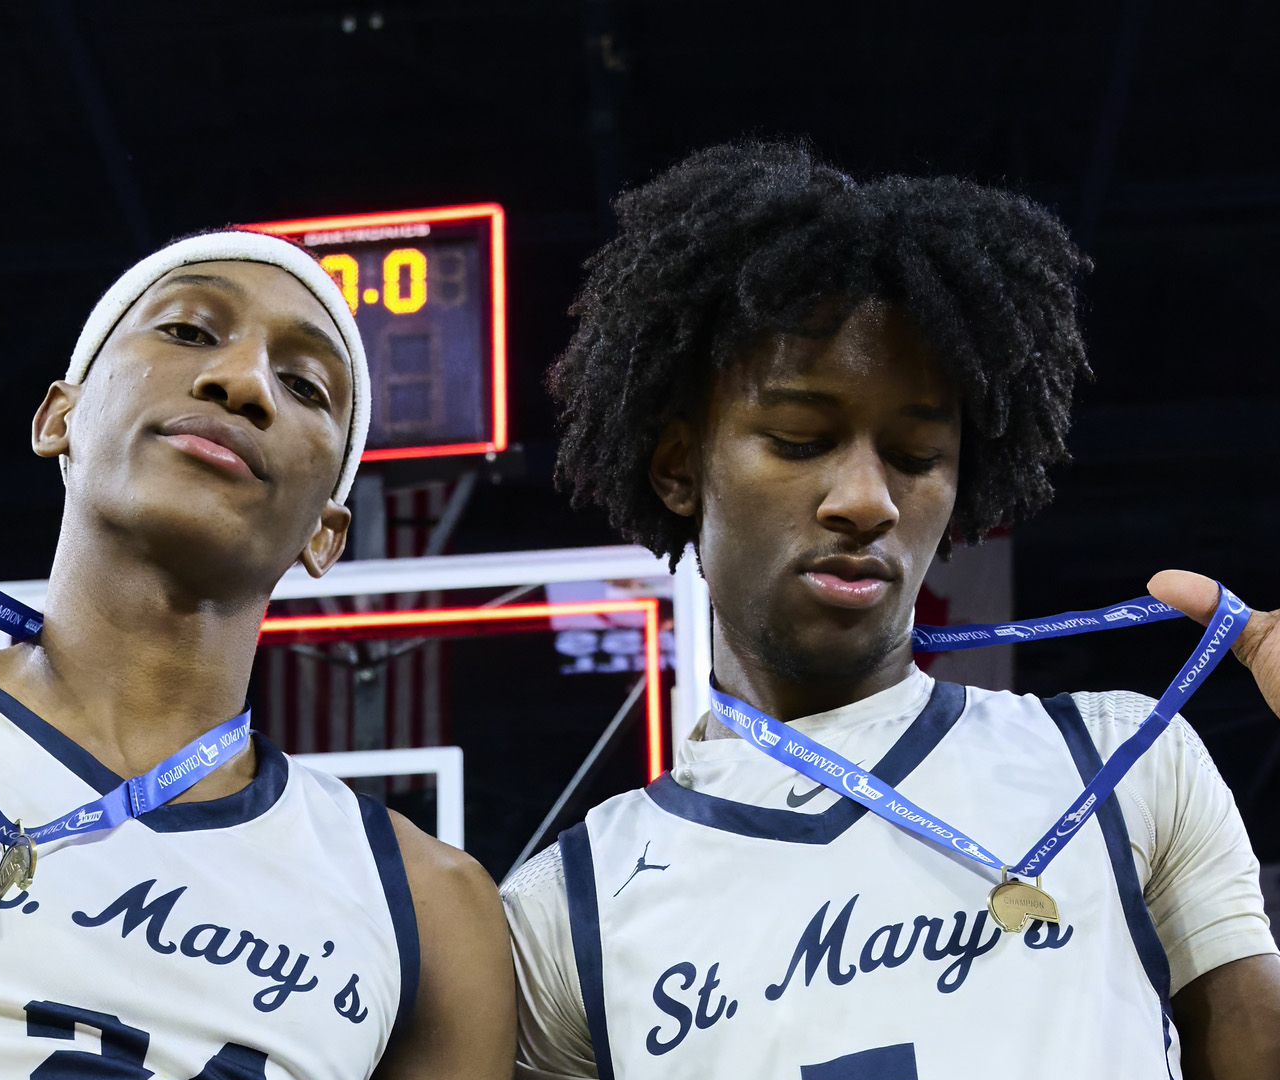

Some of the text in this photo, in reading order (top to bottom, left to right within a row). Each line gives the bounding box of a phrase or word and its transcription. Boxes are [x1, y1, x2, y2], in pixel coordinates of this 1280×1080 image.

[931, 630, 991, 643] CHAMPION
[1034, 617, 1101, 633] CHAMPION
[1178, 615, 1235, 694] CHAMPION
[219, 724, 248, 749] AMPION
[157, 755, 202, 790] CHAMPION
[784, 740, 845, 778] CHAMPION
[886, 799, 955, 839] CHAMPION
[1021, 837, 1058, 875] CHAM
[1003, 896, 1045, 909] CHAMPION
[71, 878, 369, 1024] Mary's
[645, 893, 1074, 1056] St. Marys
